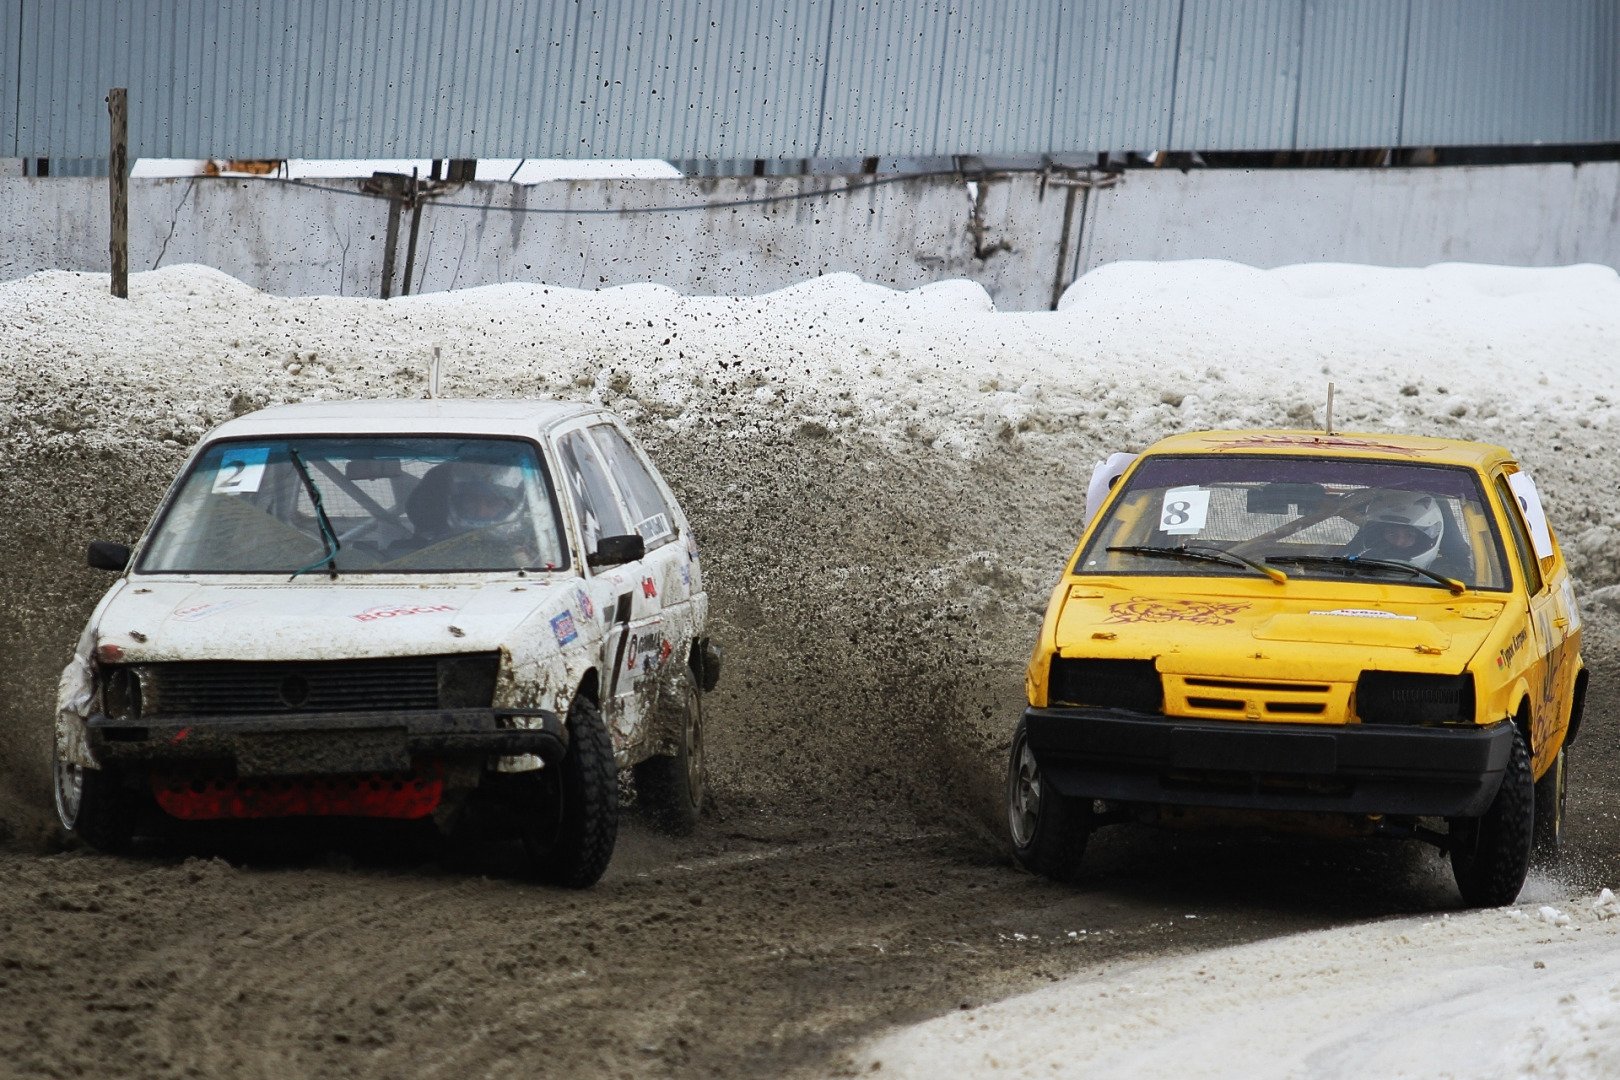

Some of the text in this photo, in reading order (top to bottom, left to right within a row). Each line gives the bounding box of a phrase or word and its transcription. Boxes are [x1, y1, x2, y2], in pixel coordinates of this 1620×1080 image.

[217, 460, 246, 487] 2
[1163, 501, 1191, 525] 8
[353, 605, 455, 622] BOSCH
